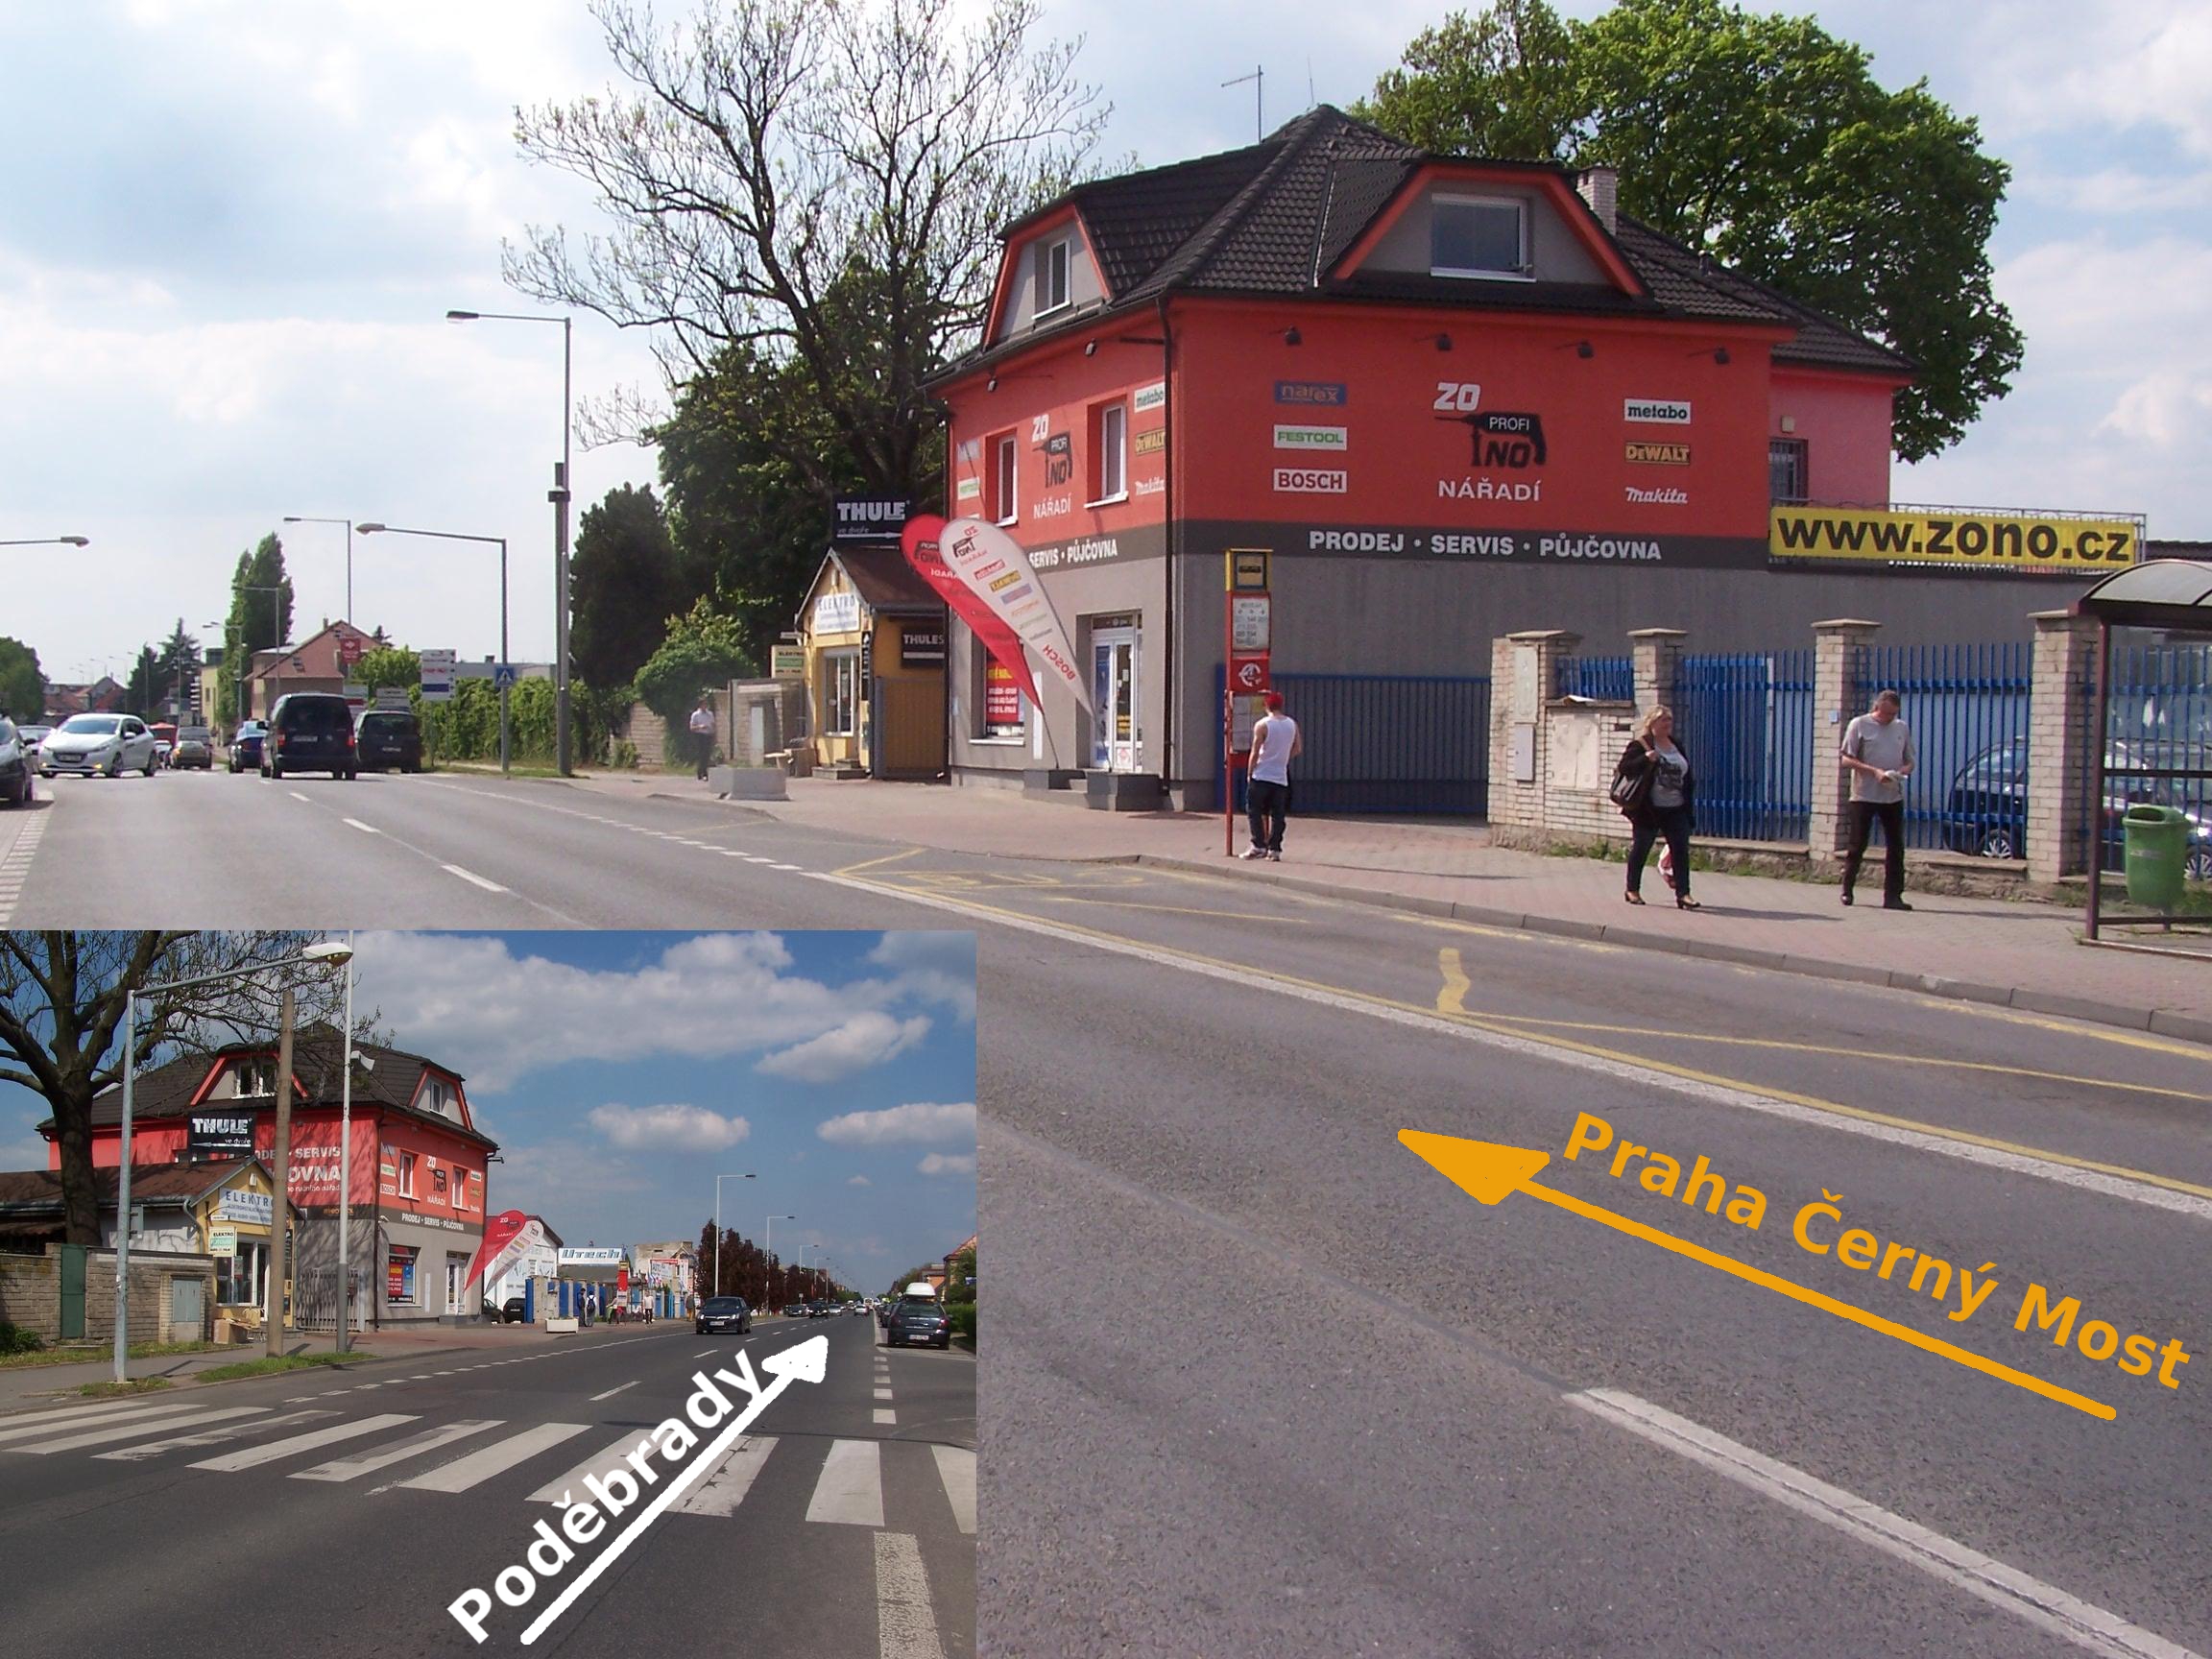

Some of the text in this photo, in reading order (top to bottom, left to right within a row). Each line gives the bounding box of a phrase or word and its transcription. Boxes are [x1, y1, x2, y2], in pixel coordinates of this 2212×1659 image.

[1433, 382, 1481, 411] ZO
[1626, 403, 1689, 421] metabo
[1031, 414, 1050, 443] ZO
[1489, 416, 1530, 432] PROFI
[1277, 430, 1344, 445] FESTOOL
[1278, 471, 1343, 491] BOSCH
[1438, 477, 1542, 502] NÁŘADÍ
[836, 501, 906, 521] THULE
[1033, 493, 1071, 519] NÁŘADÍ
[1309, 530, 1663, 561] PRODEJ SERVIS PŮJČOVNA
[1777, 517, 2131, 562] www.zono.cz
[1029, 539, 1118, 568] SERVIS PŮJČOVNA
[192, 1118, 249, 1134] THULE
[295, 1146, 341, 1159] SERVIS
[226, 1191, 273, 1207] ELEKTR
[402, 1213, 421, 1224] PRODEJ
